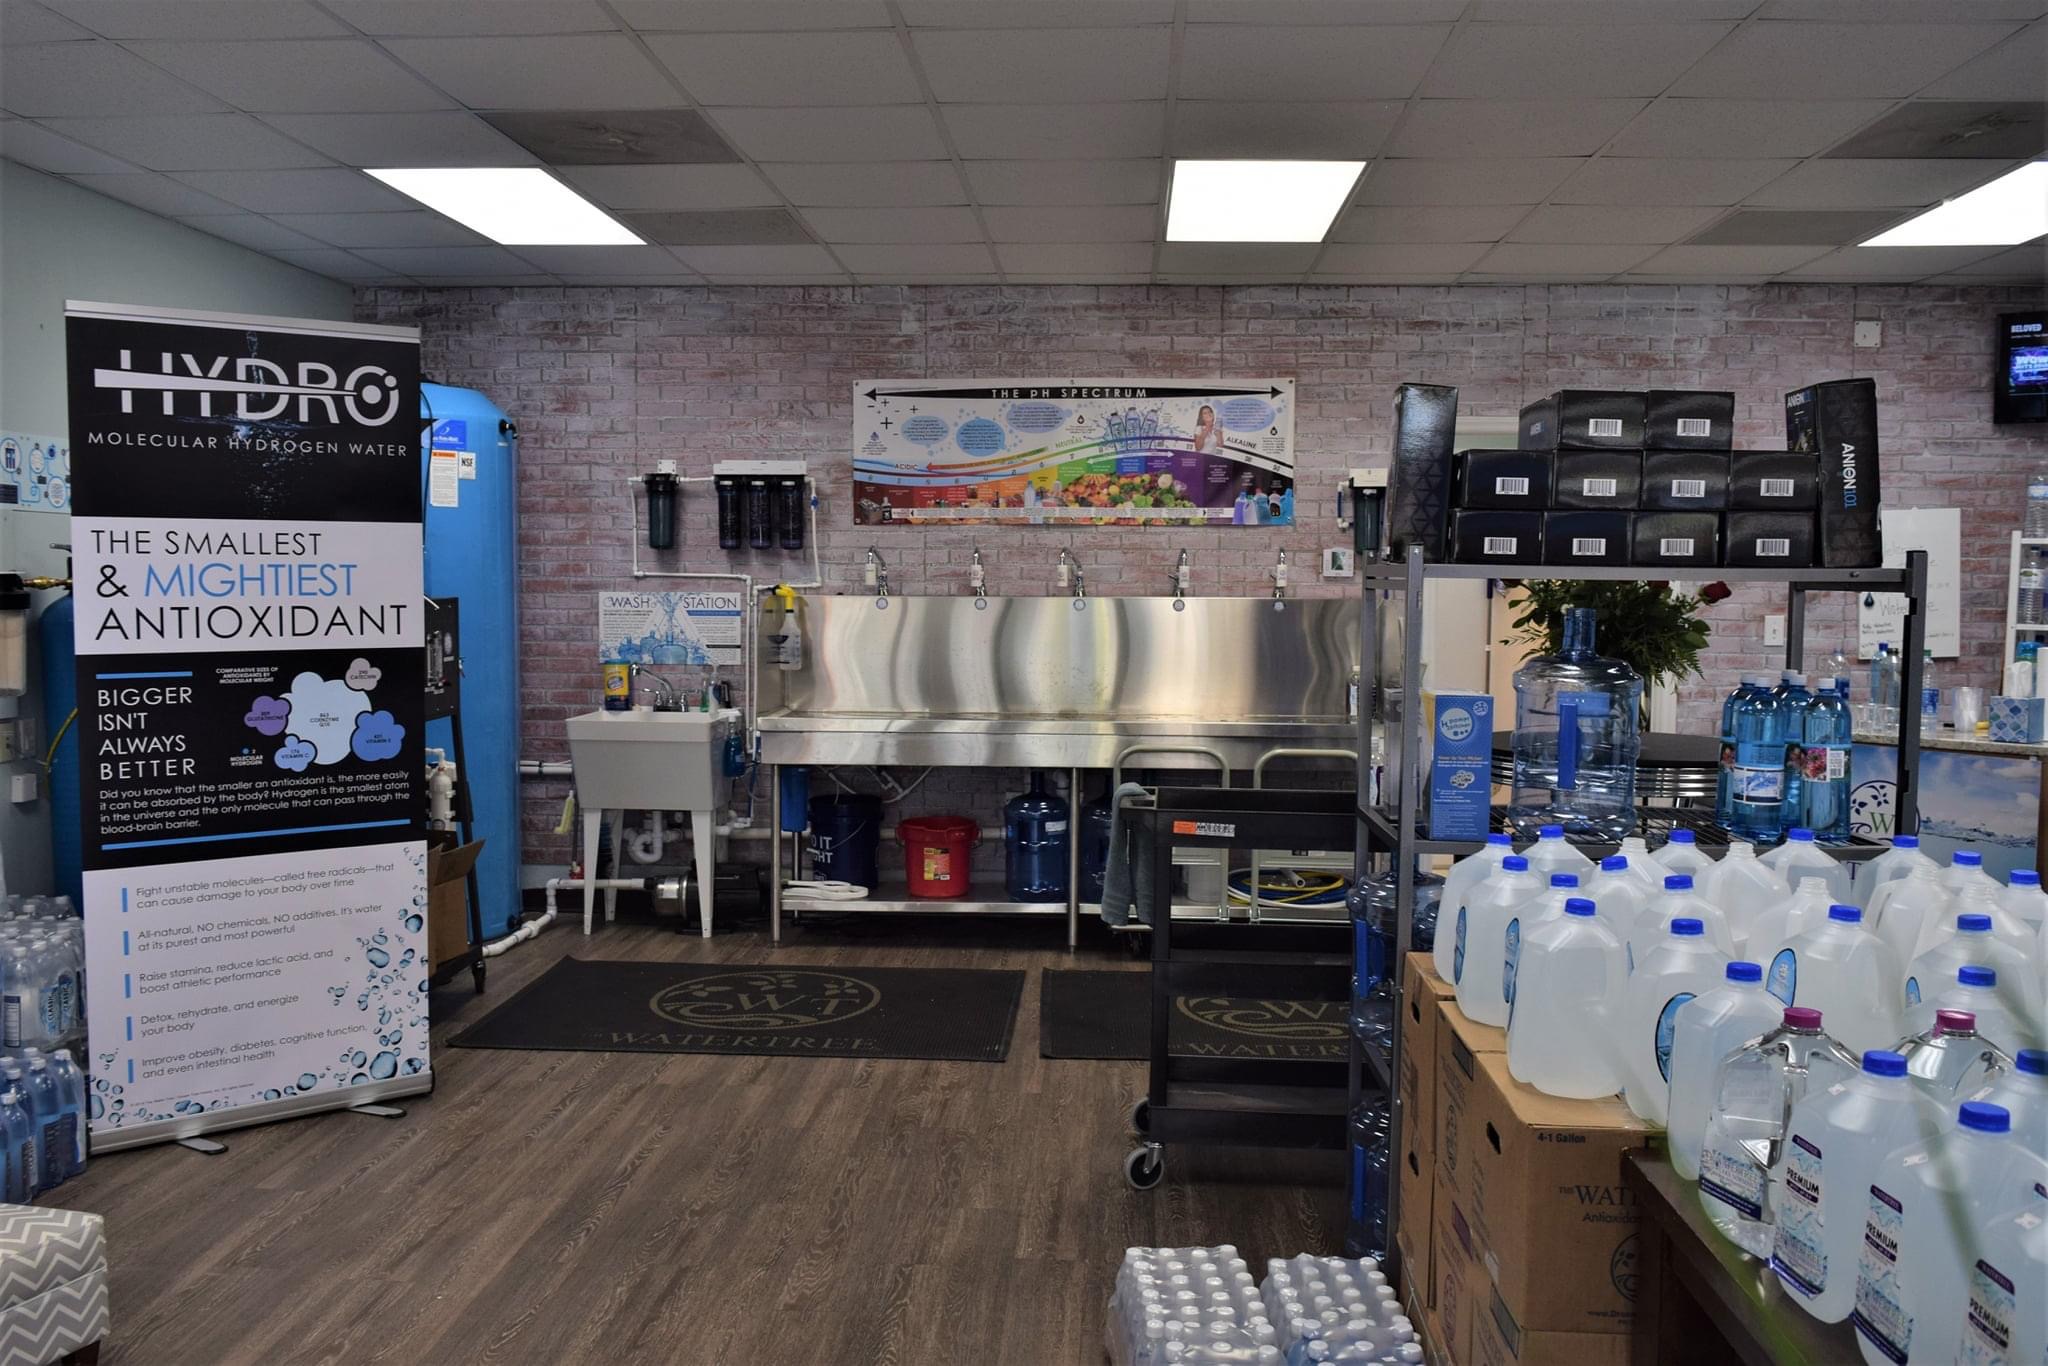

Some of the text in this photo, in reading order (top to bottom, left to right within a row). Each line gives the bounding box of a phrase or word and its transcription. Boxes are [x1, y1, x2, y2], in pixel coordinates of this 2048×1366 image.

[95, 349, 399, 427] HYDRO
[991, 388, 1147, 398] THE pH SPECTRUM
[88, 432, 407, 457] MOLECULAR HYDROGEN WATER
[1226, 436, 1257, 449] ALKALINE
[91, 530, 322, 556] THE SMALLEST
[96, 563, 358, 598] & MIGHTIEST
[610, 596, 737, 609] WASH STATION
[95, 604, 407, 640] ANTIOXIDANT
[97, 687, 193, 707] BIGGER
[98, 712, 149, 731] ISN'T
[98, 734, 186, 756] ALWAYS
[100, 758, 195, 780] BETTER
[99, 789, 118, 799] Did
[120, 789, 141, 801] you
[143, 787, 172, 796] know
[174, 784, 196, 794] that
[198, 783, 216, 792] the
[217, 780, 253, 791] smaller
[254, 780, 268, 788] an
[270, 775, 325, 787] antioxidant
[337, 774, 354, 782] the
[355, 773, 380, 781] more
[381, 770, 409, 784] easily
[99, 782, 409, 810] it can be absorbed by the body? Hydrogen is the smallest atom
[99, 791, 410, 822] in the universe and the only molecule that can pass through the
[100, 818, 200, 834] blood-brain barrier.
[819, 836, 833, 849] IT
[136, 886, 162, 898] Fight
[164, 881, 210, 894] unstable
[306, 870, 326, 879] free
[136, 878, 354, 909] can cause damage to your body over time
[196, 922, 214, 932] NO
[272, 913, 290, 923] NO
[354, 904, 382, 913] water
[138, 924, 295, 951] at its purest and most powerful
[138, 970, 167, 982] Raise
[215, 960, 254, 972] reduce
[255, 955, 283, 966] lactic
[313, 948, 333, 959] and
[139, 968, 281, 994] boost athletic performance
[177, 1005, 231, 1019] rehydrate,
[233, 1000, 254, 1011] and
[256, 994, 299, 1008] energize
[140, 1022, 195, 1038] your body
[609, 1031, 877, 1050] WATERTREE
[141, 1053, 186, 1067] Improve
[187, 1046, 227, 1060] obesity,
[229, 1039, 276, 1052] diabetes,
[278, 1031, 324, 1044] cognitive
[142, 1049, 275, 1079] and even intestinal health
[1537, 1133, 1586, 1143] 4-1 Gallon
[1786, 1166, 1820, 1197] PREMIUM
[1866, 1220, 1898, 1254] PREMIUM
[1969, 1298, 2010, 1339] PREMIUM
